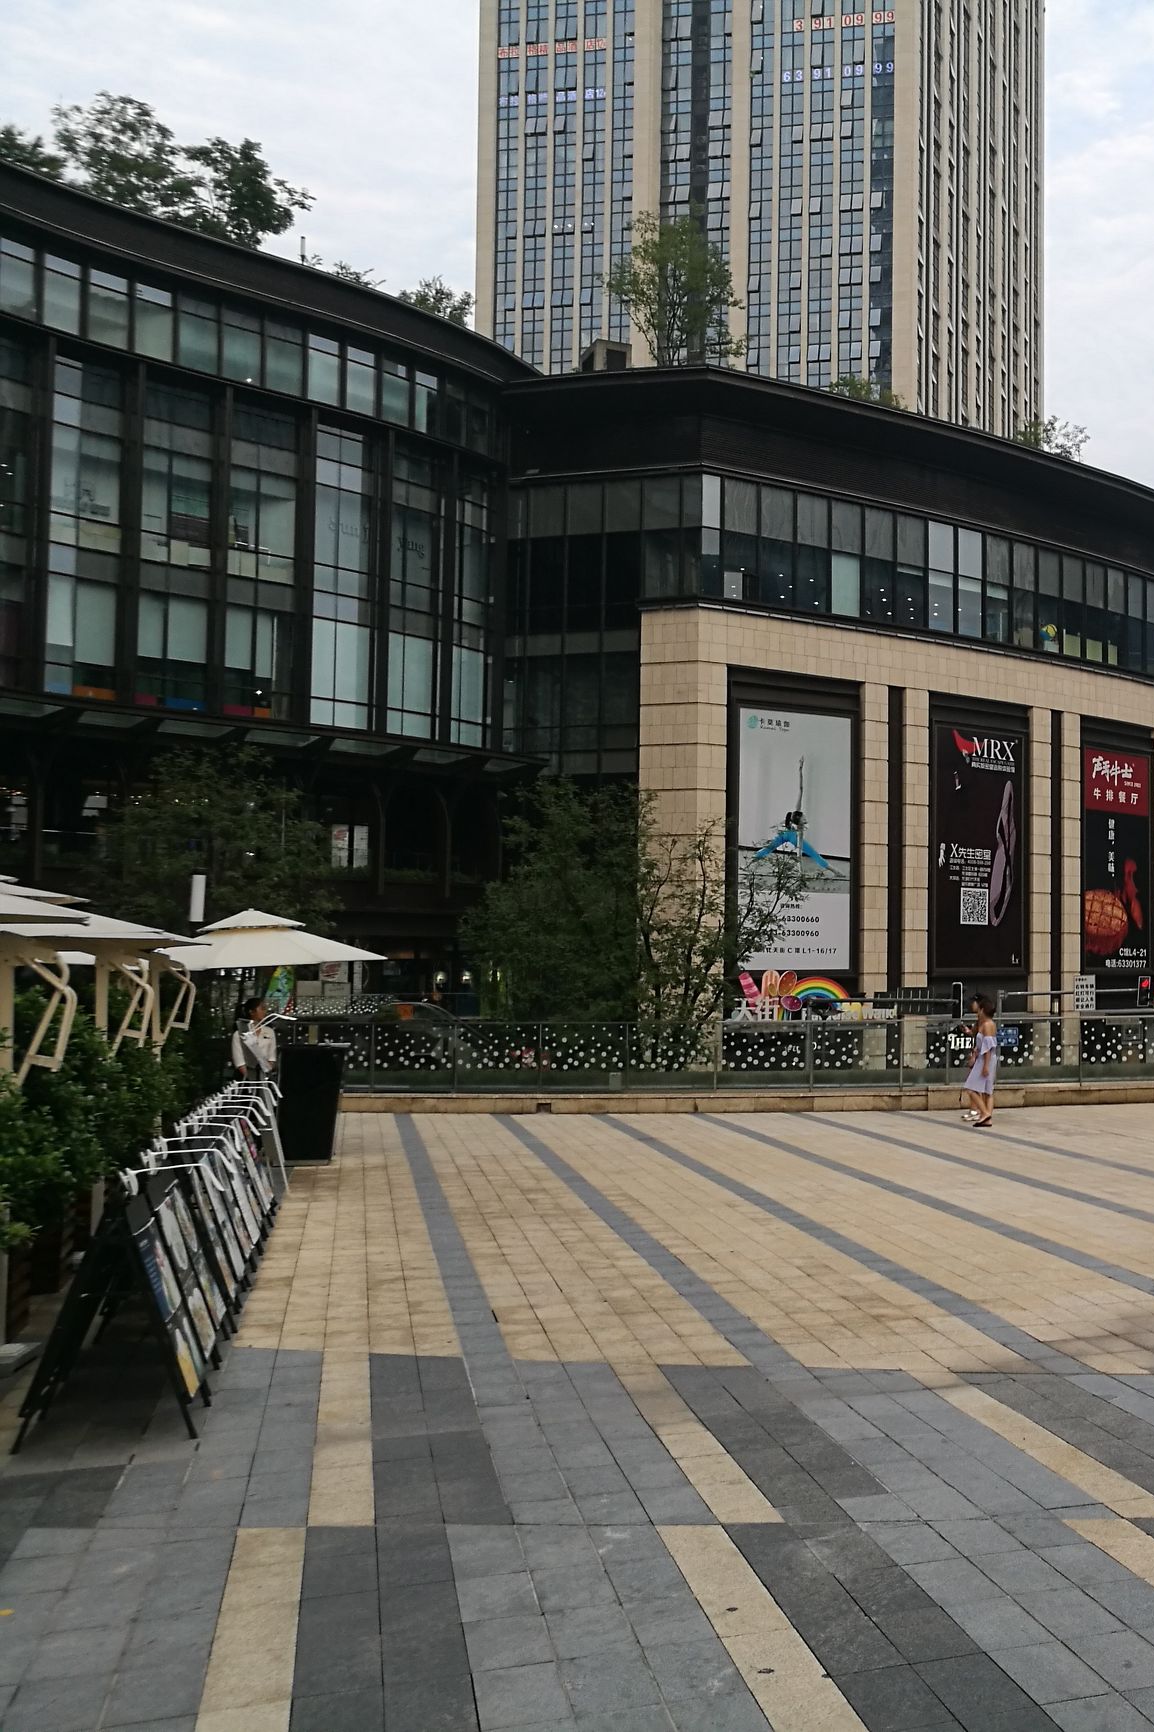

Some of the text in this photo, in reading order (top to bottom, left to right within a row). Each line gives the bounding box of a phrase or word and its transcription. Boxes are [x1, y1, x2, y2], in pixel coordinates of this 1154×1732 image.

[783, 62, 894, 82] 63910999
[972, 736, 1015, 762] MRX
[1093, 787, 1139, 805] 牛排餐厅
[950, 843, 992, 861] X先生密室
